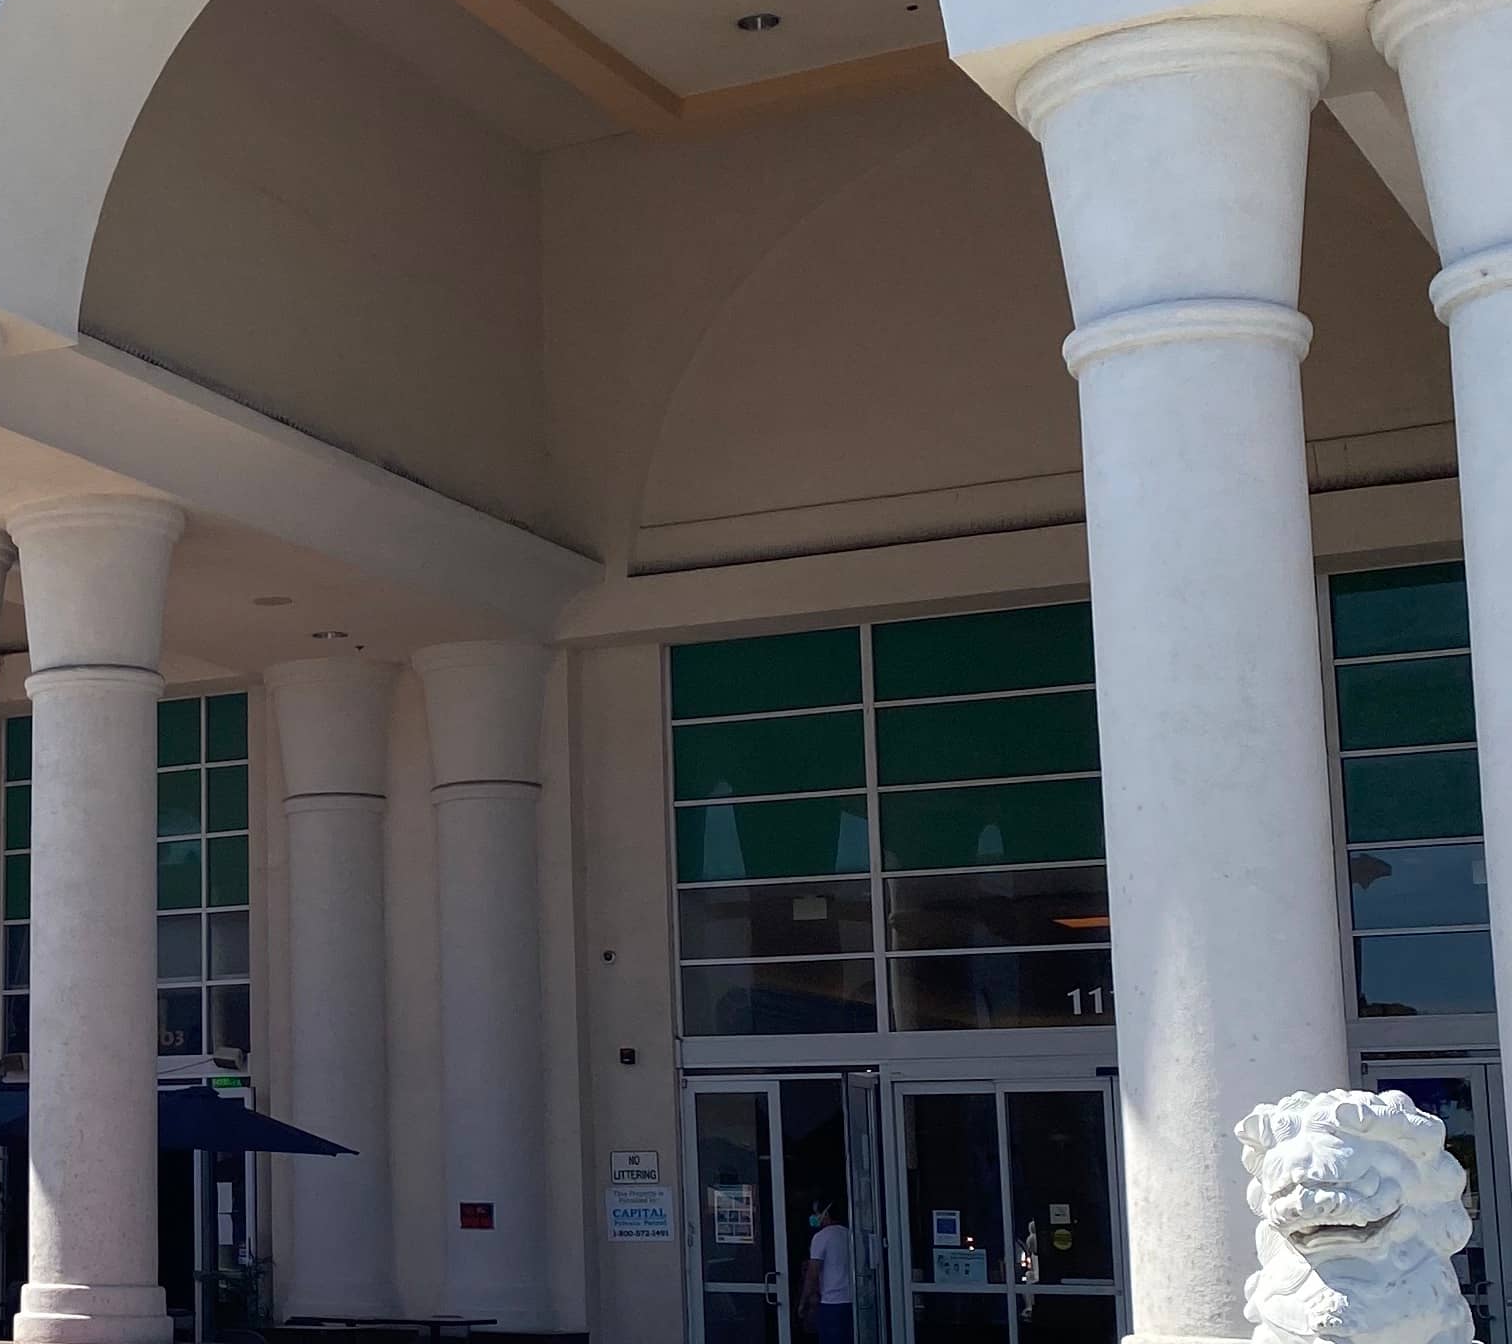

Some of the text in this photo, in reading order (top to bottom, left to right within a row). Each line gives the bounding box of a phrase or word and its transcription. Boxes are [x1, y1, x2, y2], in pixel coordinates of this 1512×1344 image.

[1067, 987, 1114, 1015] 11
[629, 1155, 640, 1165] NO
[614, 1169, 657, 1180] LITTERING
[613, 1208, 667, 1218] CAPITAL
